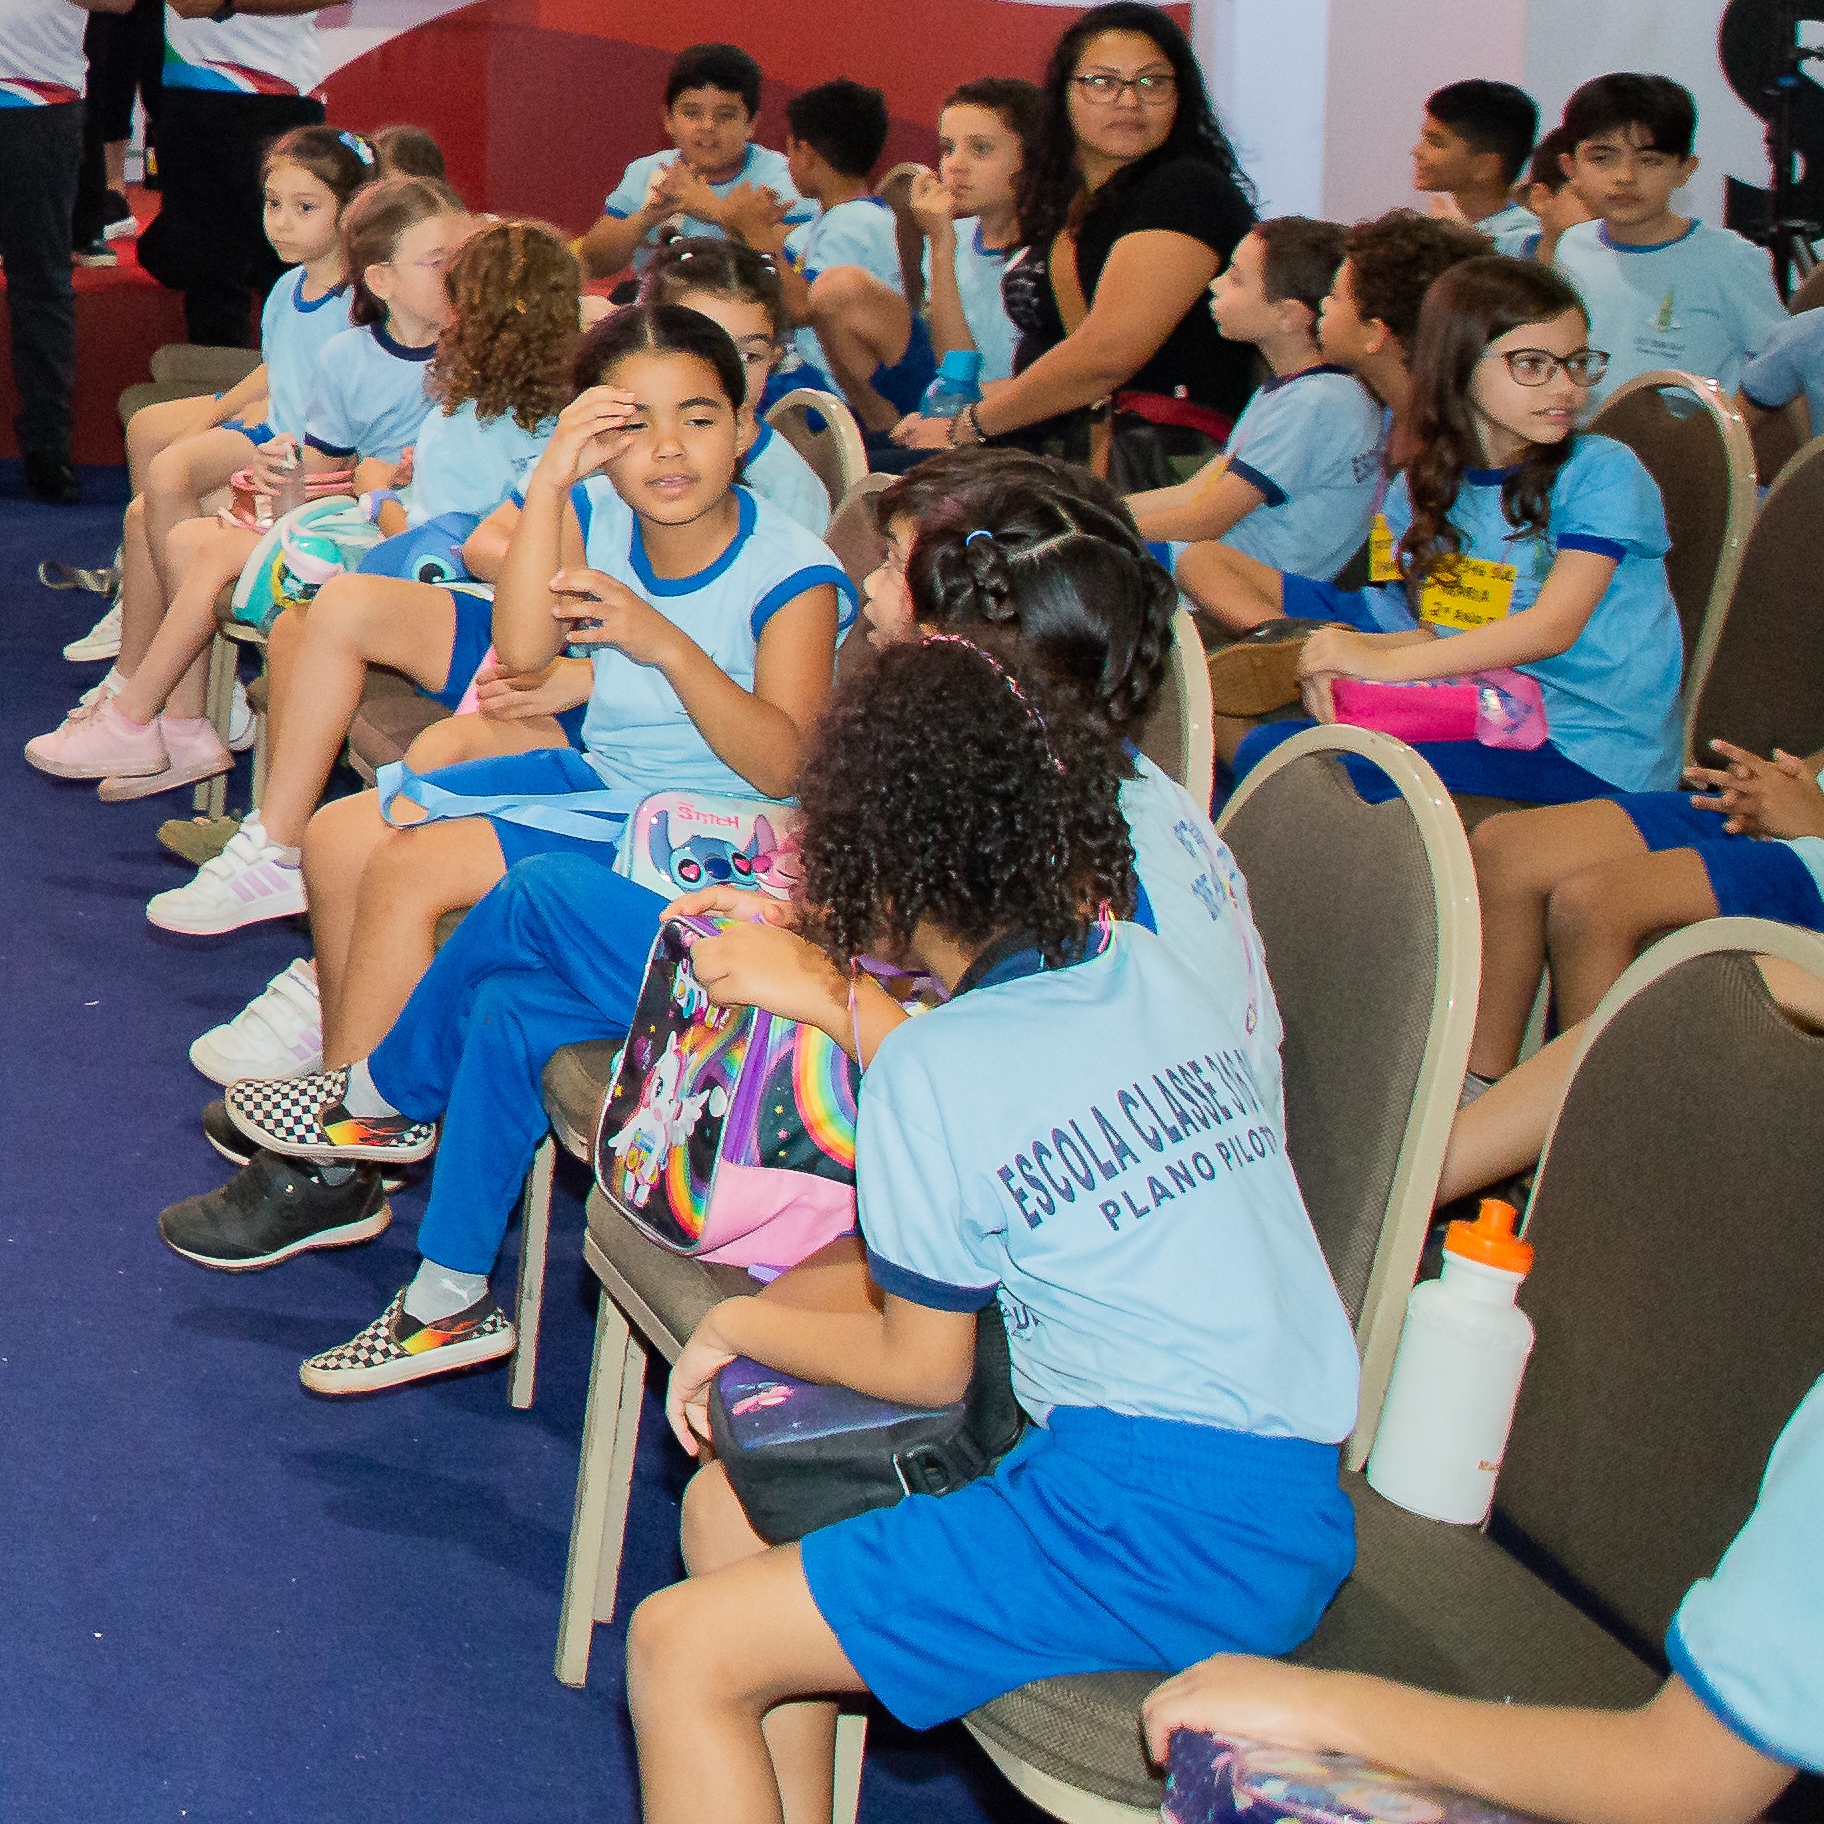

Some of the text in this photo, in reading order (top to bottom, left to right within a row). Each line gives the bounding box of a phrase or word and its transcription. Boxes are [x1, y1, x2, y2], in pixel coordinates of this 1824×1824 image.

[997, 1105, 1141, 1230] ESCOLA
[1116, 1059, 1234, 1153] CLASSE
[1099, 1151, 1215, 1232] PLANO
